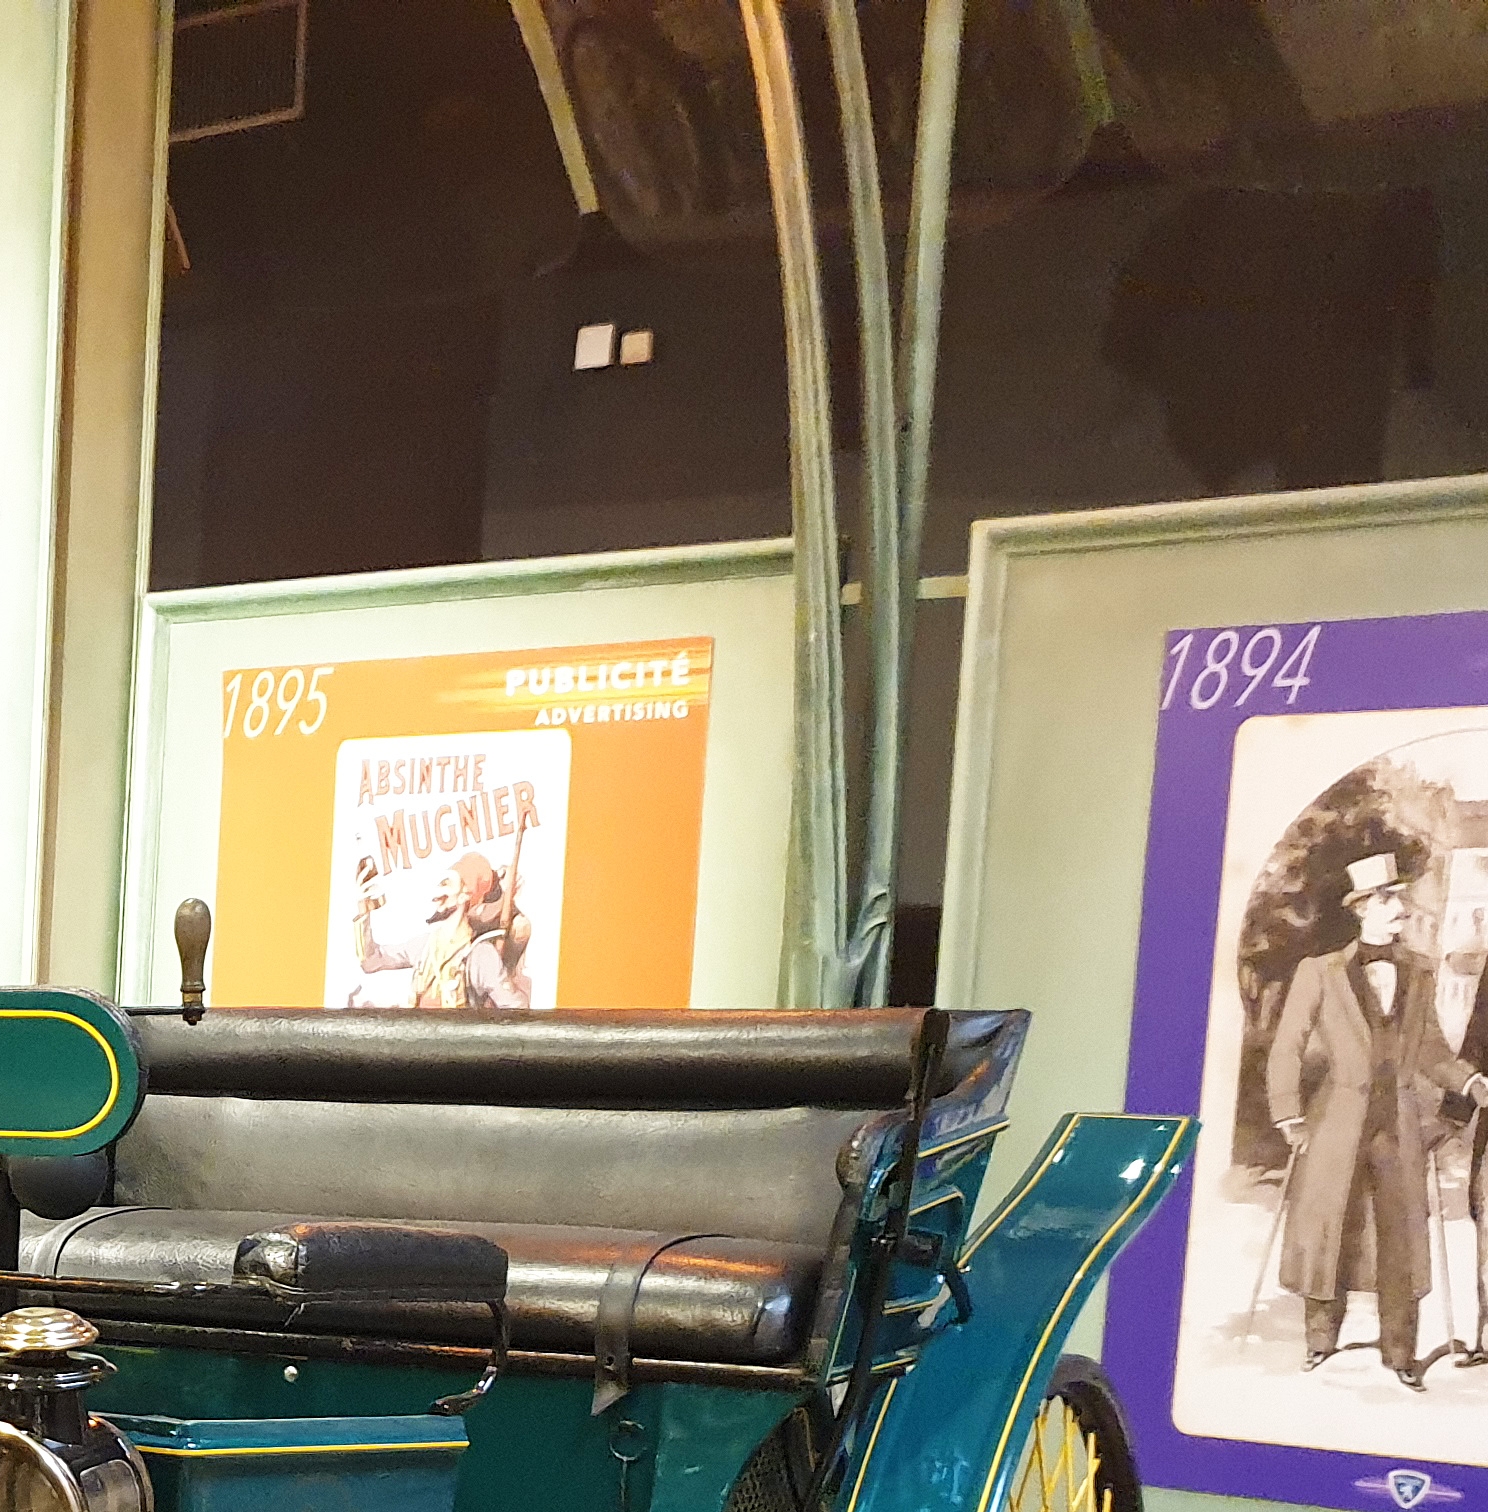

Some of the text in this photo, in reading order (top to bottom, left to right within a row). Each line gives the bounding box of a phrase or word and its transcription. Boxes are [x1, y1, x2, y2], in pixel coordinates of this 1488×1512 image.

[505, 651, 690, 697] PUBLICITÉ
[1160, 624, 1323, 711] 1894
[224, 667, 335, 738] 1895
[534, 700, 689, 727] ADVERTISING
[357, 754, 487, 807] ABSINTHE
[374, 781, 541, 876] MUGNIER
